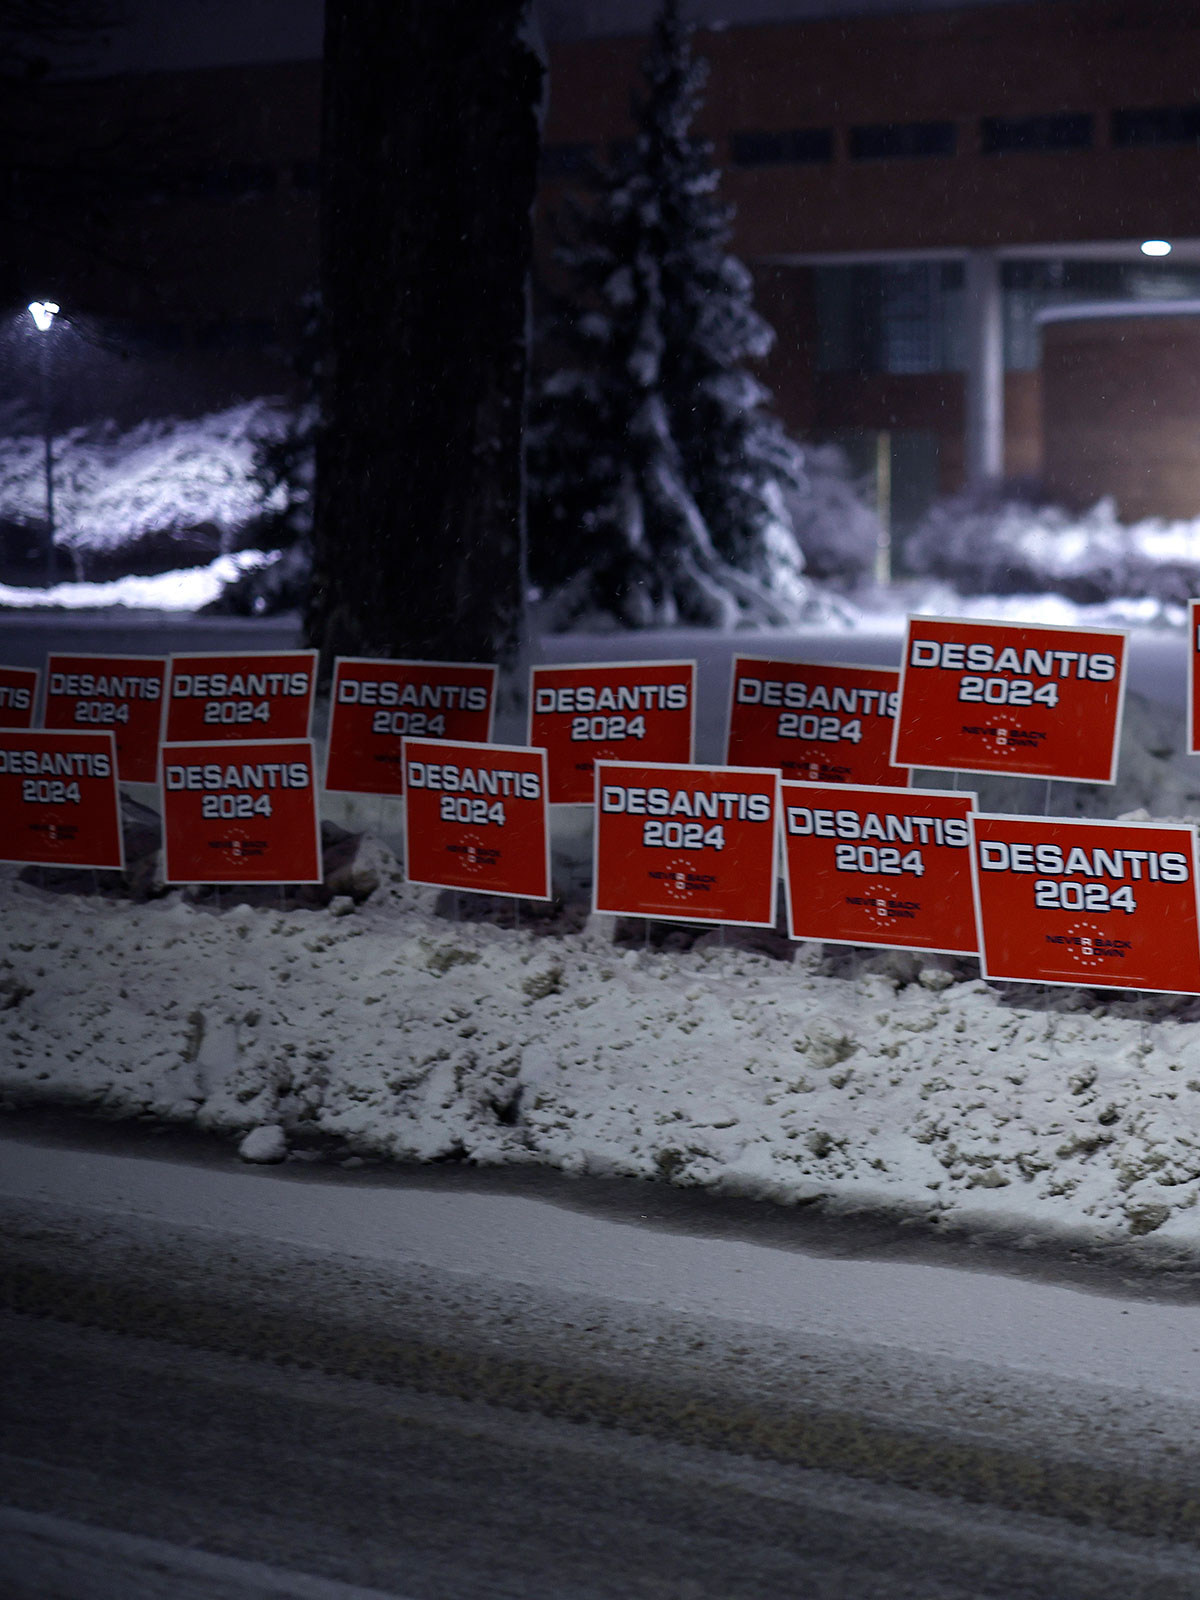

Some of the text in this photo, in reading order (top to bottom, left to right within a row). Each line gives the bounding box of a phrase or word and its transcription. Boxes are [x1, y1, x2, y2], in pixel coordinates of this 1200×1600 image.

[910, 639, 1115, 683] DESANTIS
[50, 673, 160, 700] DESANTIS
[173, 673, 308, 698] DESANTIS
[338, 680, 488, 711] DESANTIS
[535, 684, 688, 714] DESANTIS
[958, 675, 1059, 709] 2024
[75, 702, 129, 724] 2024
[204, 702, 270, 724] 2024
[373, 711, 445, 736] 2024
[571, 716, 647, 741] 2024
[777, 714, 863, 745] 2024
[22, 780, 81, 804] 2024
[166, 763, 309, 791] DESANTIS
[408, 763, 540, 800] DESANTIS
[202, 793, 272, 820] 2024
[440, 797, 506, 827] 2024
[601, 785, 771, 822] DESANTIS
[642, 821, 725, 851] 2024
[787, 806, 969, 848] DESANTIS
[834, 844, 925, 877] 2024
[979, 839, 1189, 883] DESANTIS
[1034, 879, 1137, 914] 2024
[1045, 934, 1131, 950] NEVER BACK
